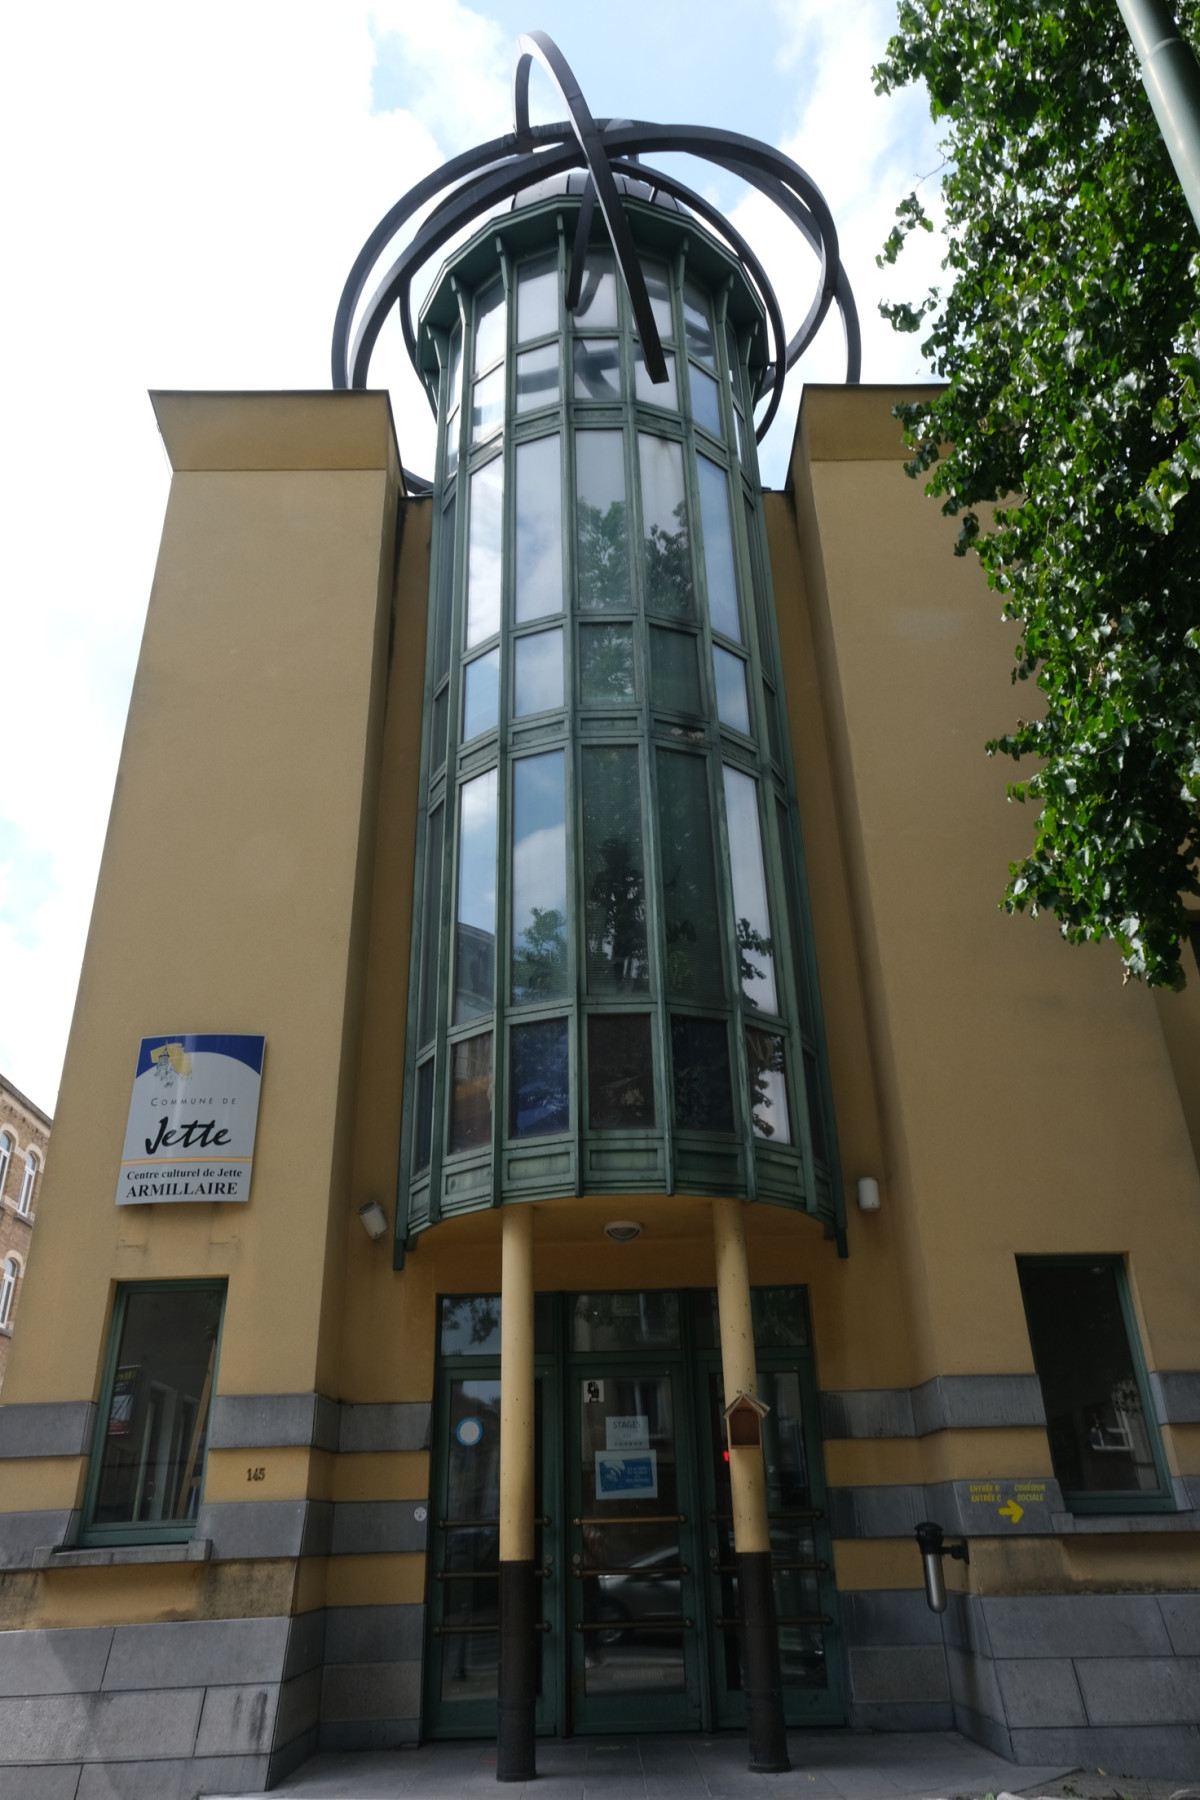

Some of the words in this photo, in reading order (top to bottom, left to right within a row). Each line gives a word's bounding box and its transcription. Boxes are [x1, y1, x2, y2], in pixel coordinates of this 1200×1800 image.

[150, 1097, 213, 1107] COMMUNE
[222, 1097, 237, 1105] DE
[145, 1116, 232, 1155] Jette
[126, 1170, 159, 1181] Centre
[161, 1168, 200, 1179] culturel
[202, 1168, 215, 1178] de
[217, 1168, 243, 1178] Jette
[126, 1182, 238, 1198] ARMILLAIRE
[970, 1483, 993, 1492] ENTRÉE
[971, 1493, 995, 1502] ENTRÉE
[996, 1493, 1001, 1502] C
[1017, 1493, 1043, 1502] SOCIALE
